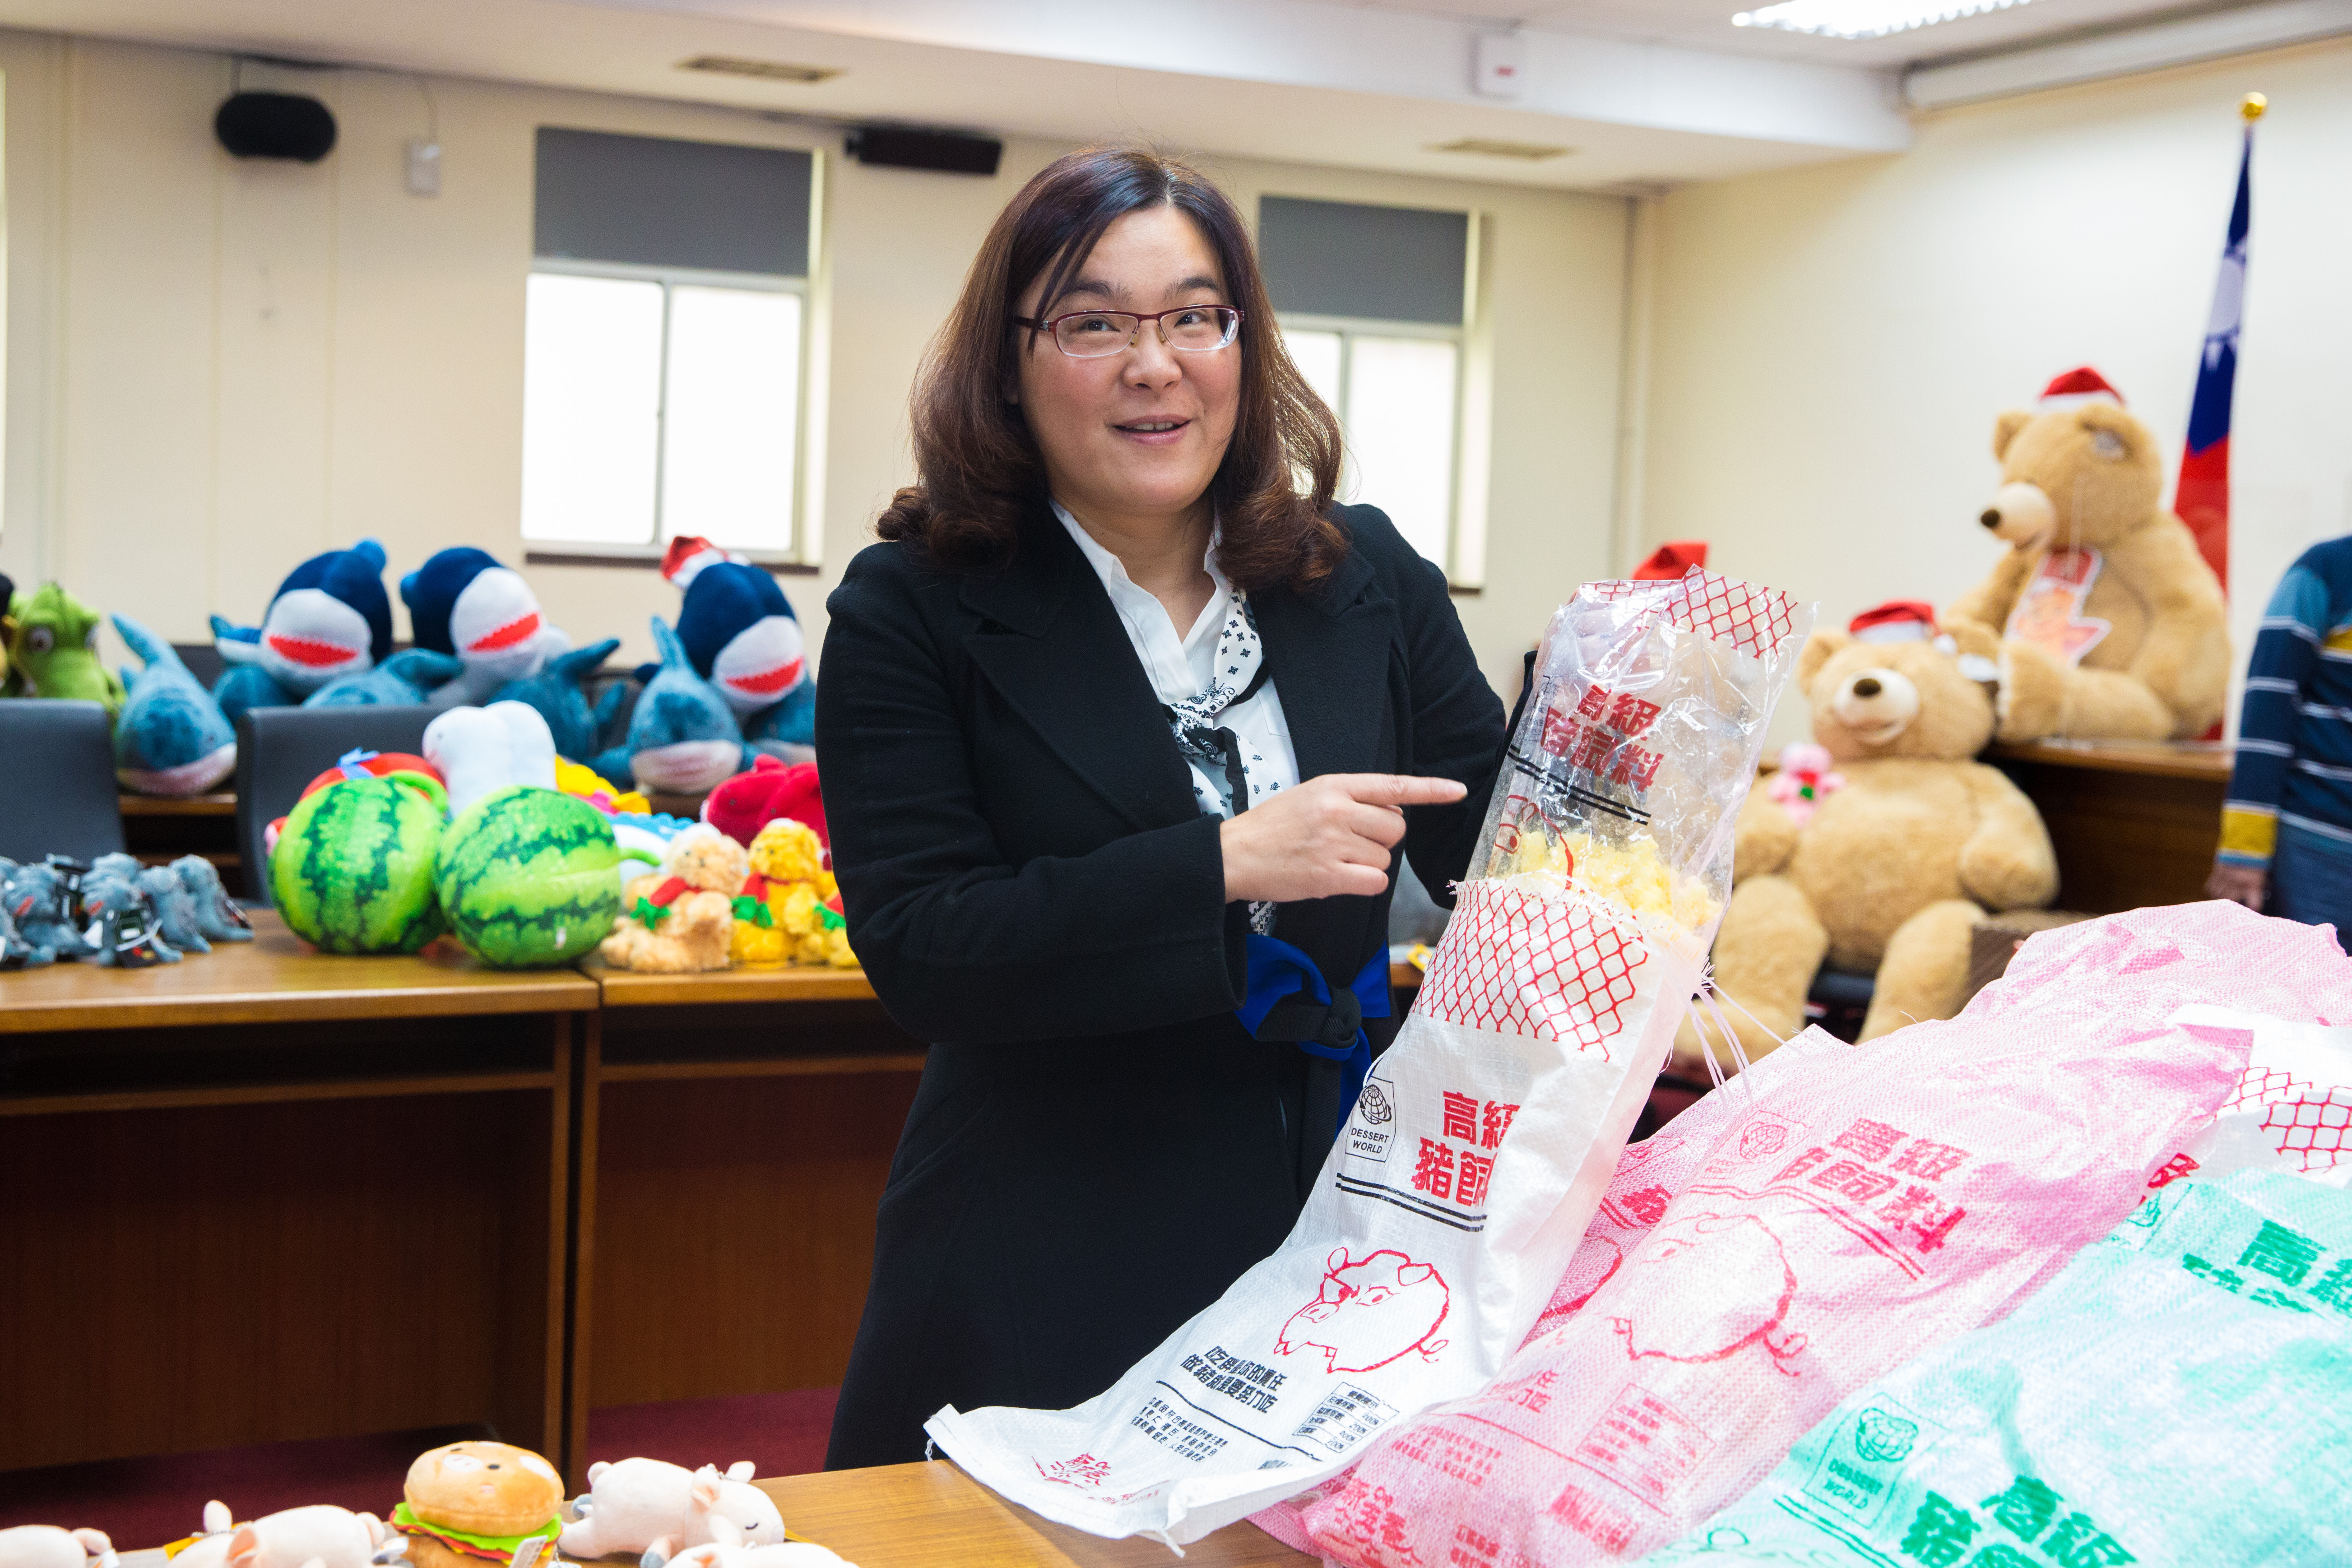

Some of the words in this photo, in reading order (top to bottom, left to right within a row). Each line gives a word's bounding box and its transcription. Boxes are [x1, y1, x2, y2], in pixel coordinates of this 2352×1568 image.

[1351, 1127, 1389, 1143] DESSERT
[1353, 1140, 1382, 1154] WORLD
[1829, 1118, 1973, 1182] 高級
[1411, 1137, 1498, 1208] 豬飼
